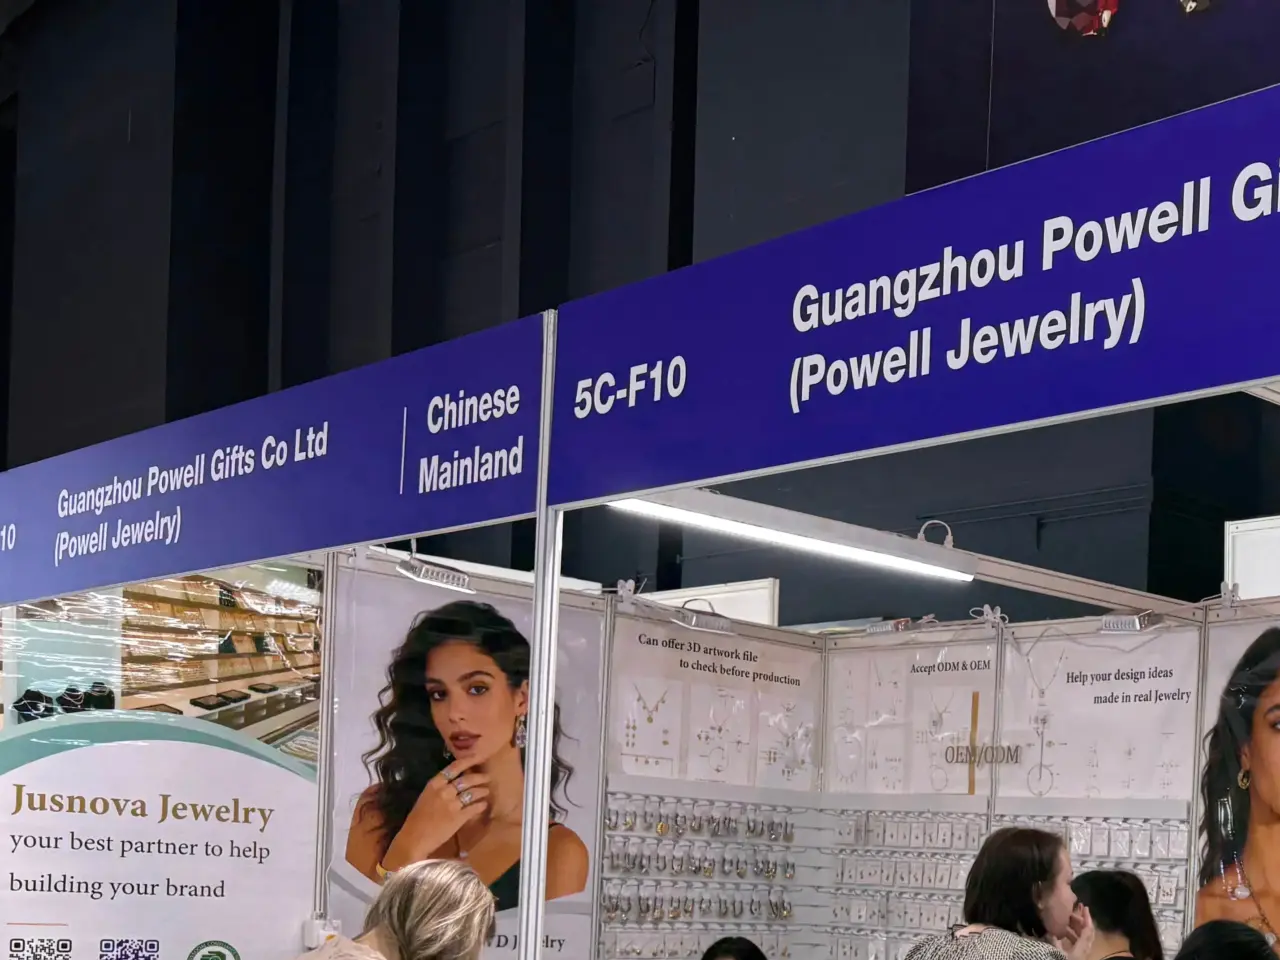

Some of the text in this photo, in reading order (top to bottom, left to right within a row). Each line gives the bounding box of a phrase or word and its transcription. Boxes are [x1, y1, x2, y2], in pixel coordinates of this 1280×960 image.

[793, 244, 1024, 332] Guangzhou
[1042, 177, 1212, 271] Powell
[789, 277, 1146, 413] (Powell Jewelry)
[573, 355, 687, 420] 5C-F10
[427, 385, 520, 434] Chinese
[58, 422, 329, 518] Guangzhou Powell Gifts Co Ltd
[418, 436, 523, 494] Mainland
[55, 505, 182, 567] (Powell Jewelry)
[638, 633, 758, 663] Can offer 3D artwork file
[910, 659, 991, 676] Accept ODM & OEM
[679, 658, 801, 687] to check before production
[1066, 666, 1174, 686] Help your design ideas
[1093, 687, 1192, 704] made in real Jewelry
[945, 743, 1021, 768] OEM/ODM
[11, 783, 275, 833] Jusnova Jewelry
[10, 831, 271, 864] your best partner to help
[9, 873, 225, 900] building your brand
